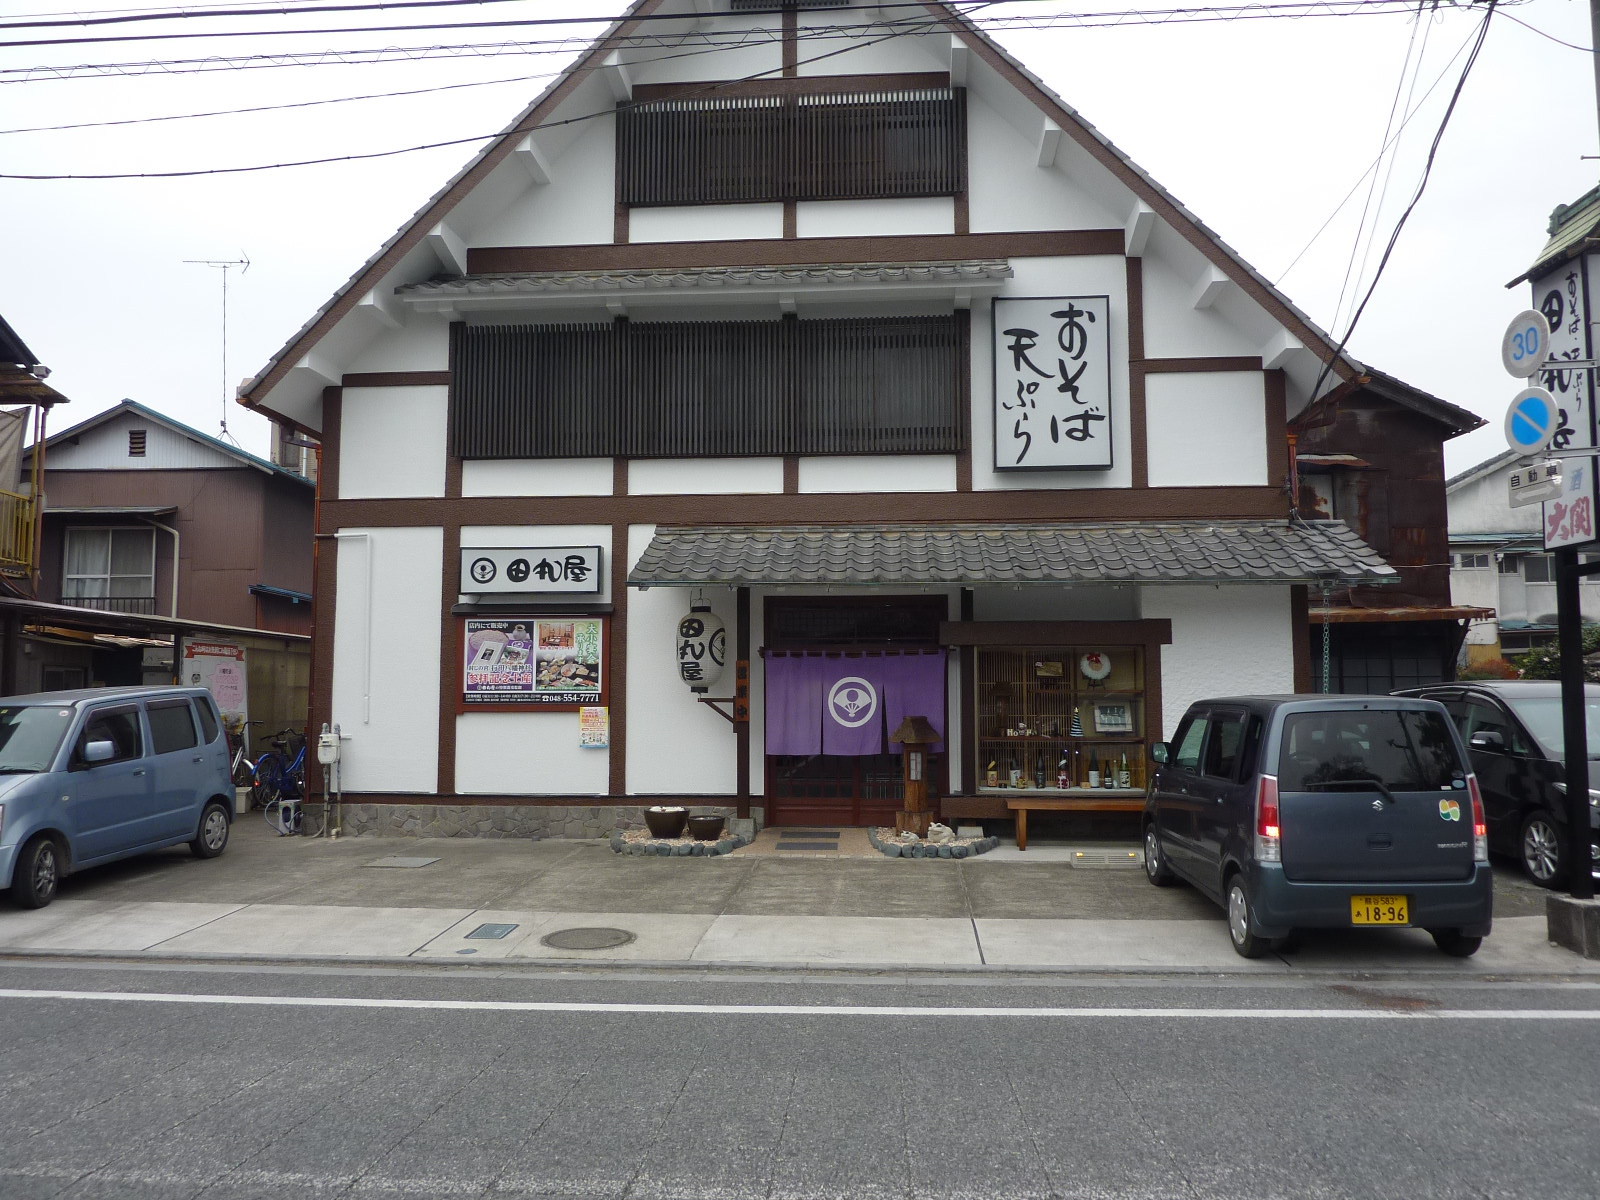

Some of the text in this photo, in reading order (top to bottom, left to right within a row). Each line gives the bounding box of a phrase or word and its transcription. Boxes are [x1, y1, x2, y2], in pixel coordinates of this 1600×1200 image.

[1512, 326, 1539, 361] 30
[1050, 302, 1106, 444] おそば
[1003, 328, 1056, 465] 天ぷら
[1511, 465, 1558, 488] 自動車
[468, 672, 532, 685] 参拝記念土産
[549, 693, 599, 702] 048-554-7771
[1366, 907, 1405, 922] 18-96
